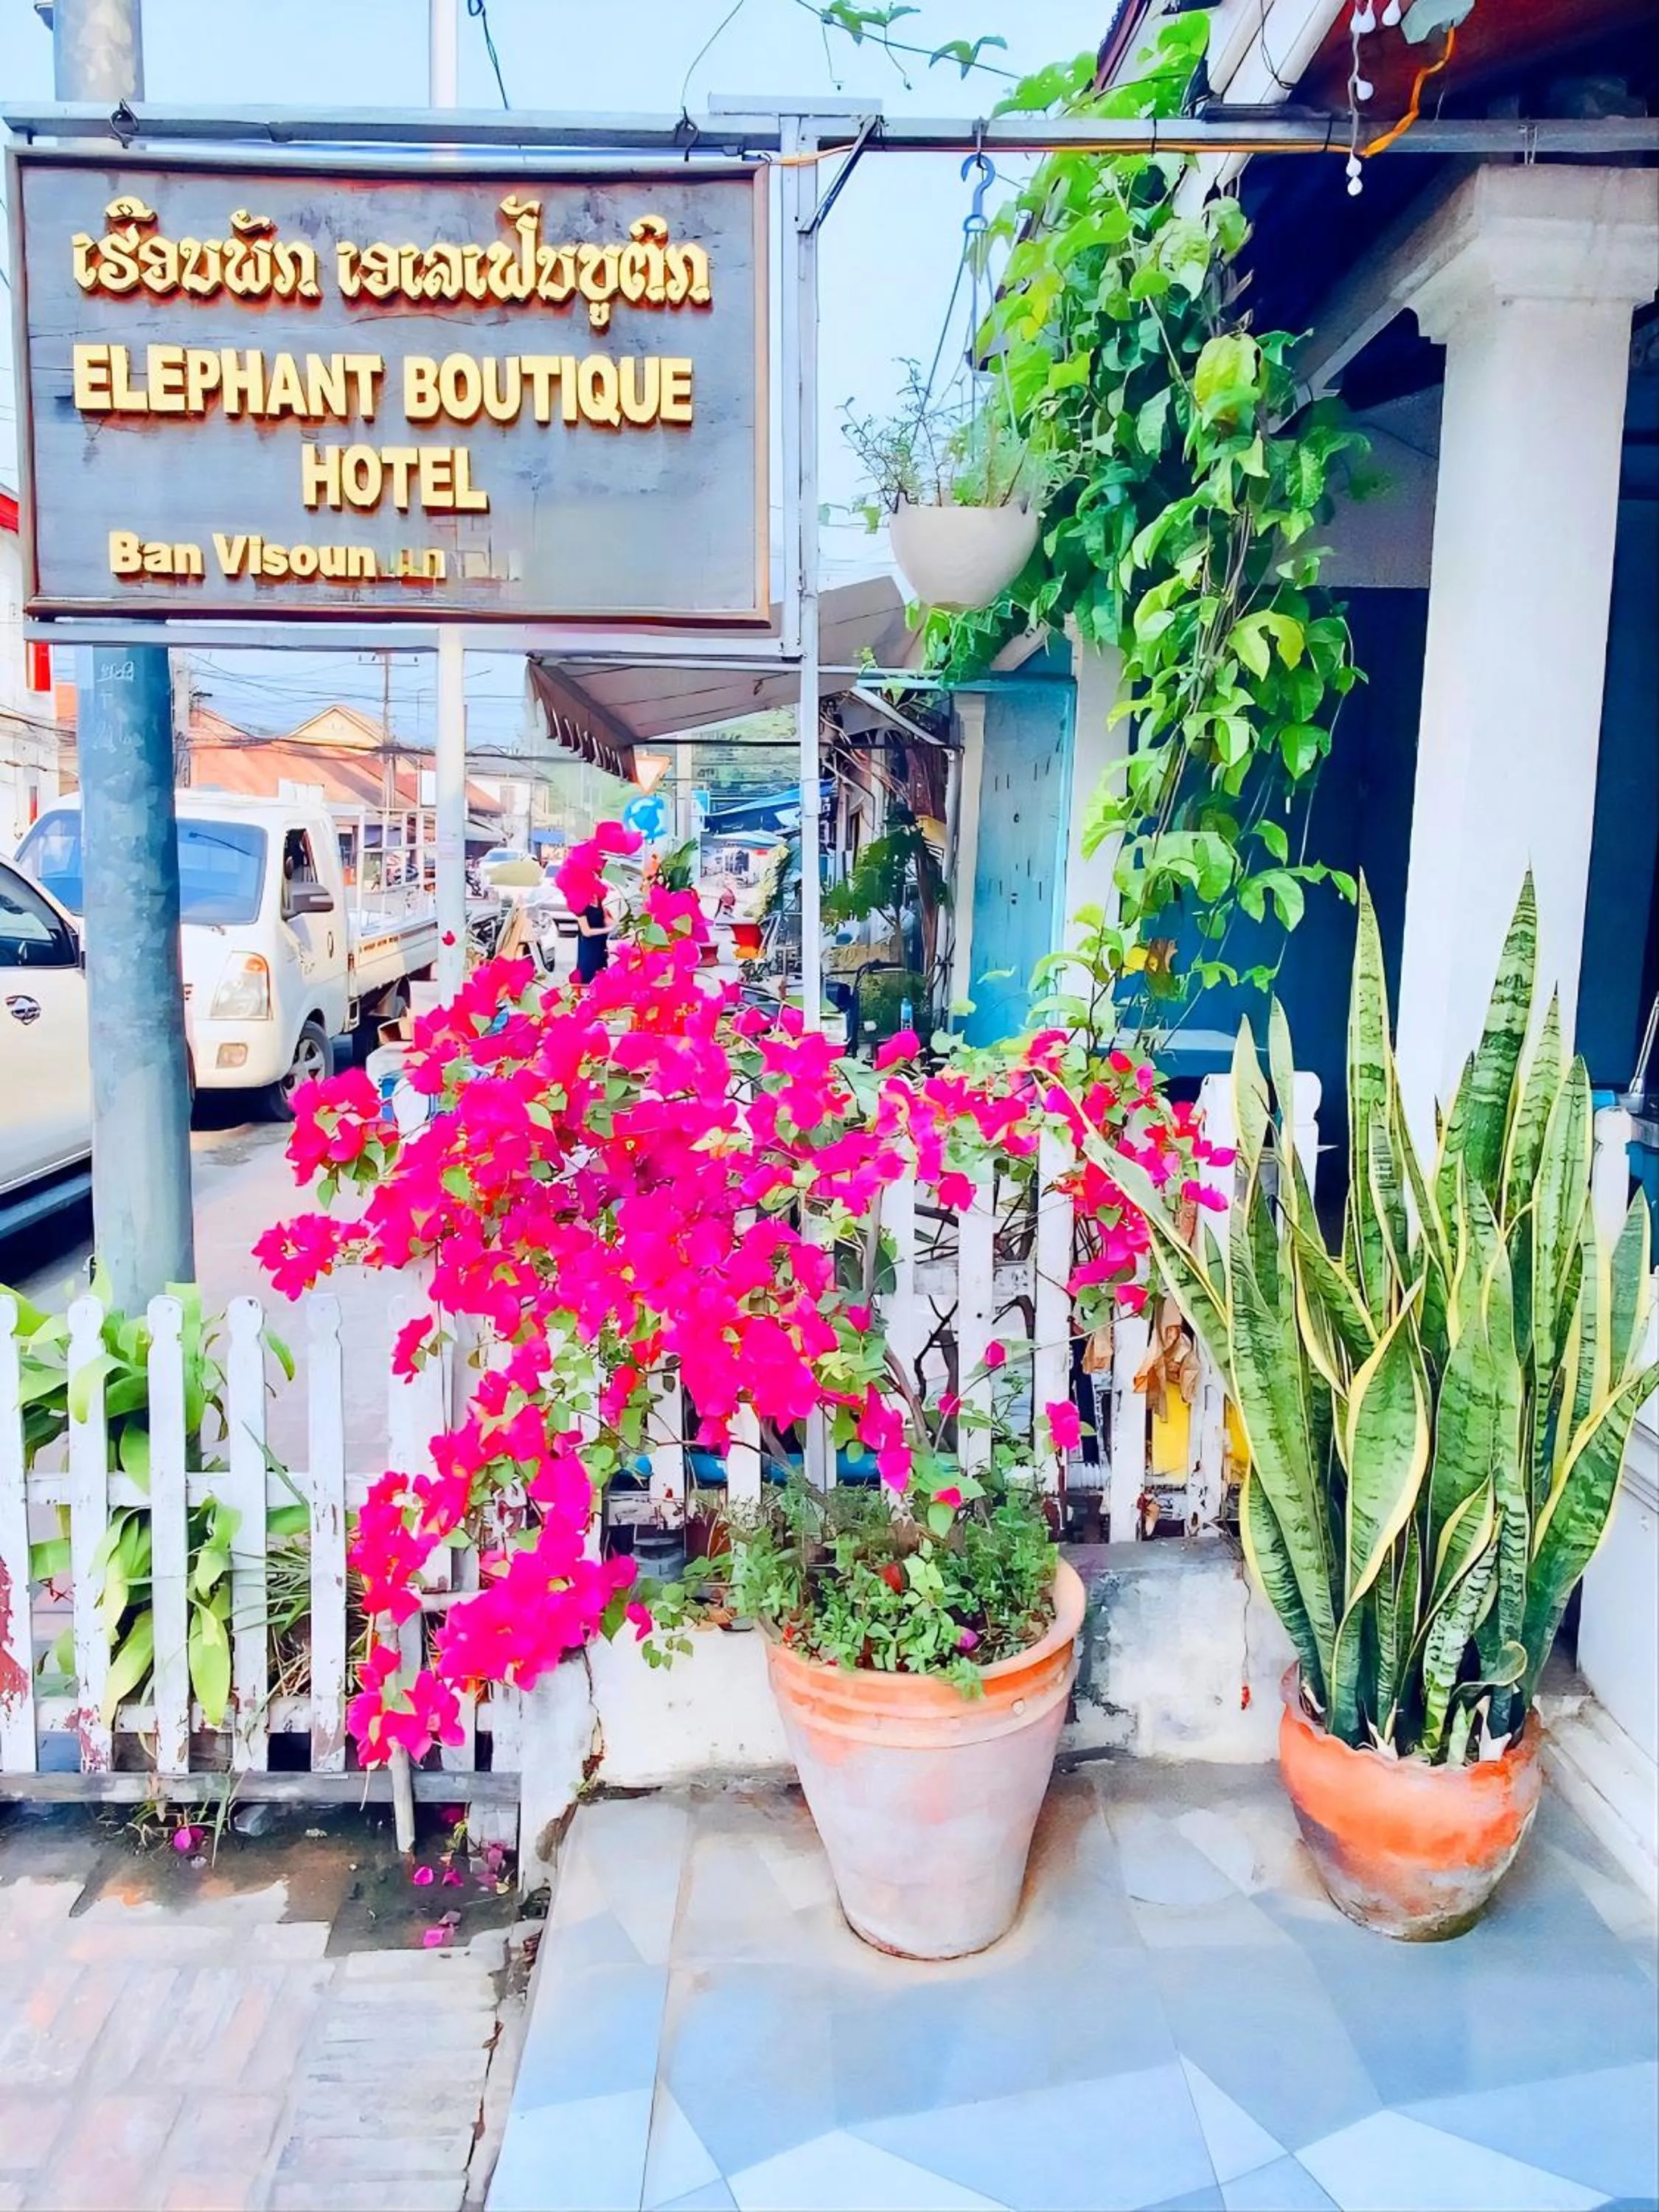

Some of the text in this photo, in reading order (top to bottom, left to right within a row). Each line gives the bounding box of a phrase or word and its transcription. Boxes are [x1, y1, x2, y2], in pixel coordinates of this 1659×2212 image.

[73, 343, 694, 426] ELEPHANT BOUTIQUE
[301, 442, 490, 512] HOTEL
[108, 530, 205, 578] Ban
